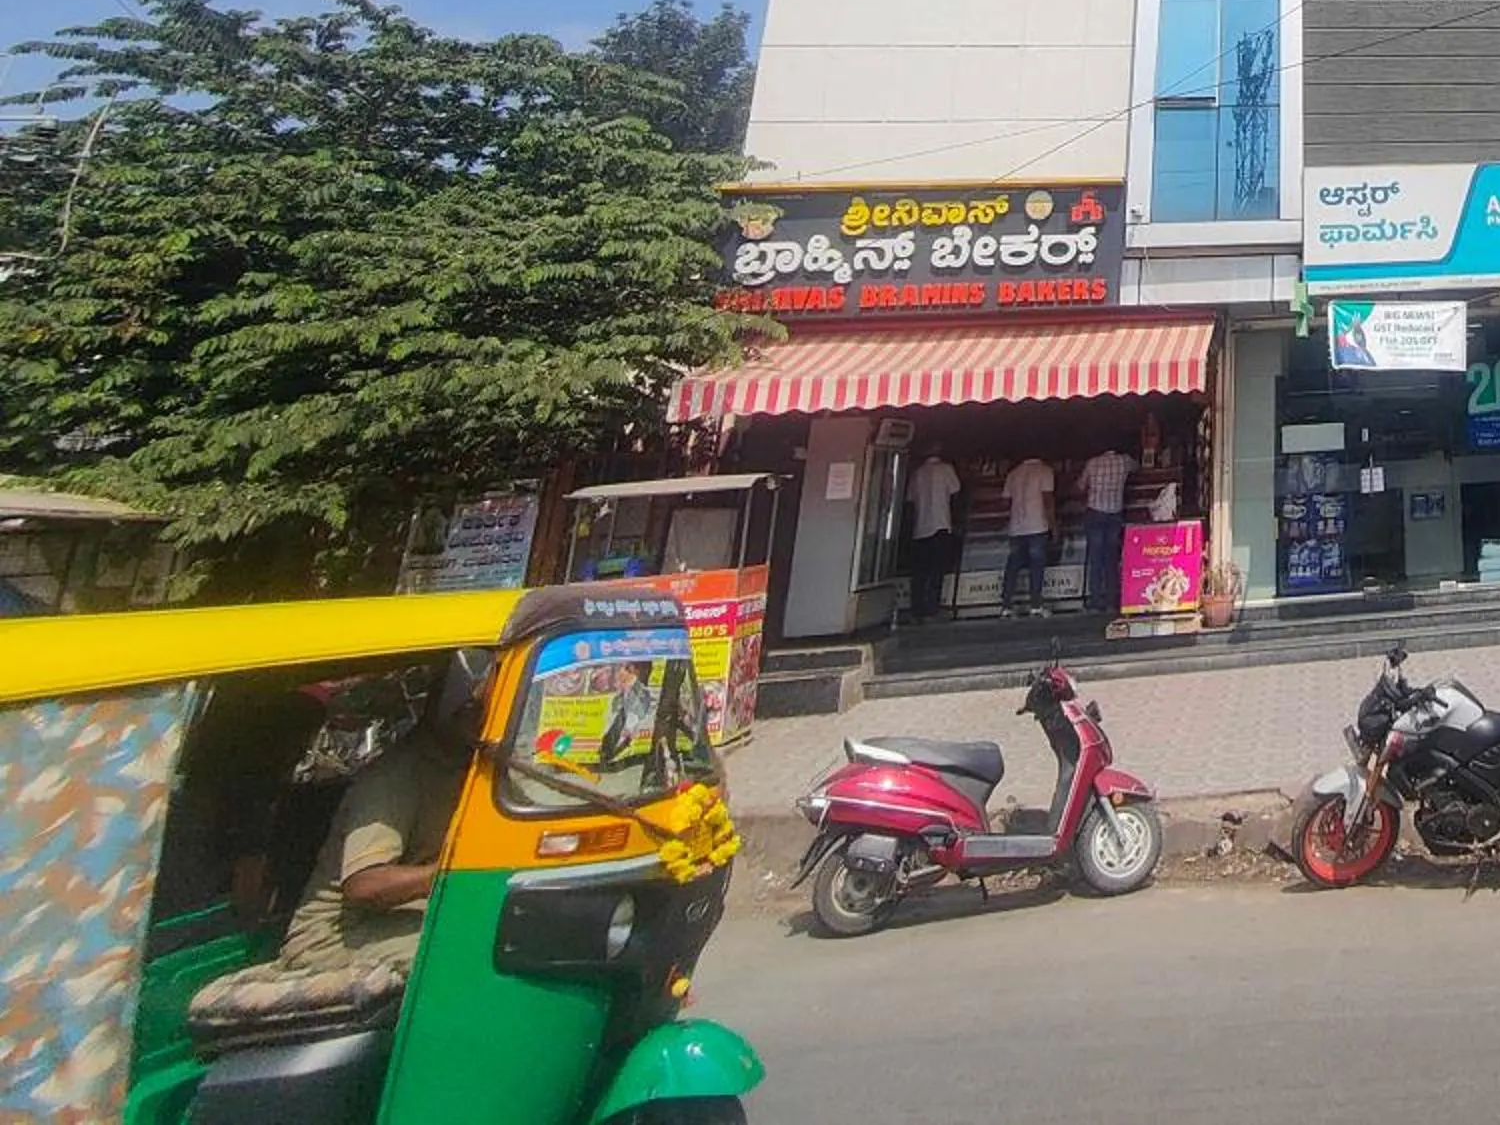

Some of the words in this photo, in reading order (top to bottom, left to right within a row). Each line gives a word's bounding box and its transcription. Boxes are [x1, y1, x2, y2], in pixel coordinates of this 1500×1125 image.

[1318, 181, 1400, 217] ಆಸ್ಟರ್
[859, 282, 986, 309] BRAMINS
[999, 277, 1108, 303] BAKERS
